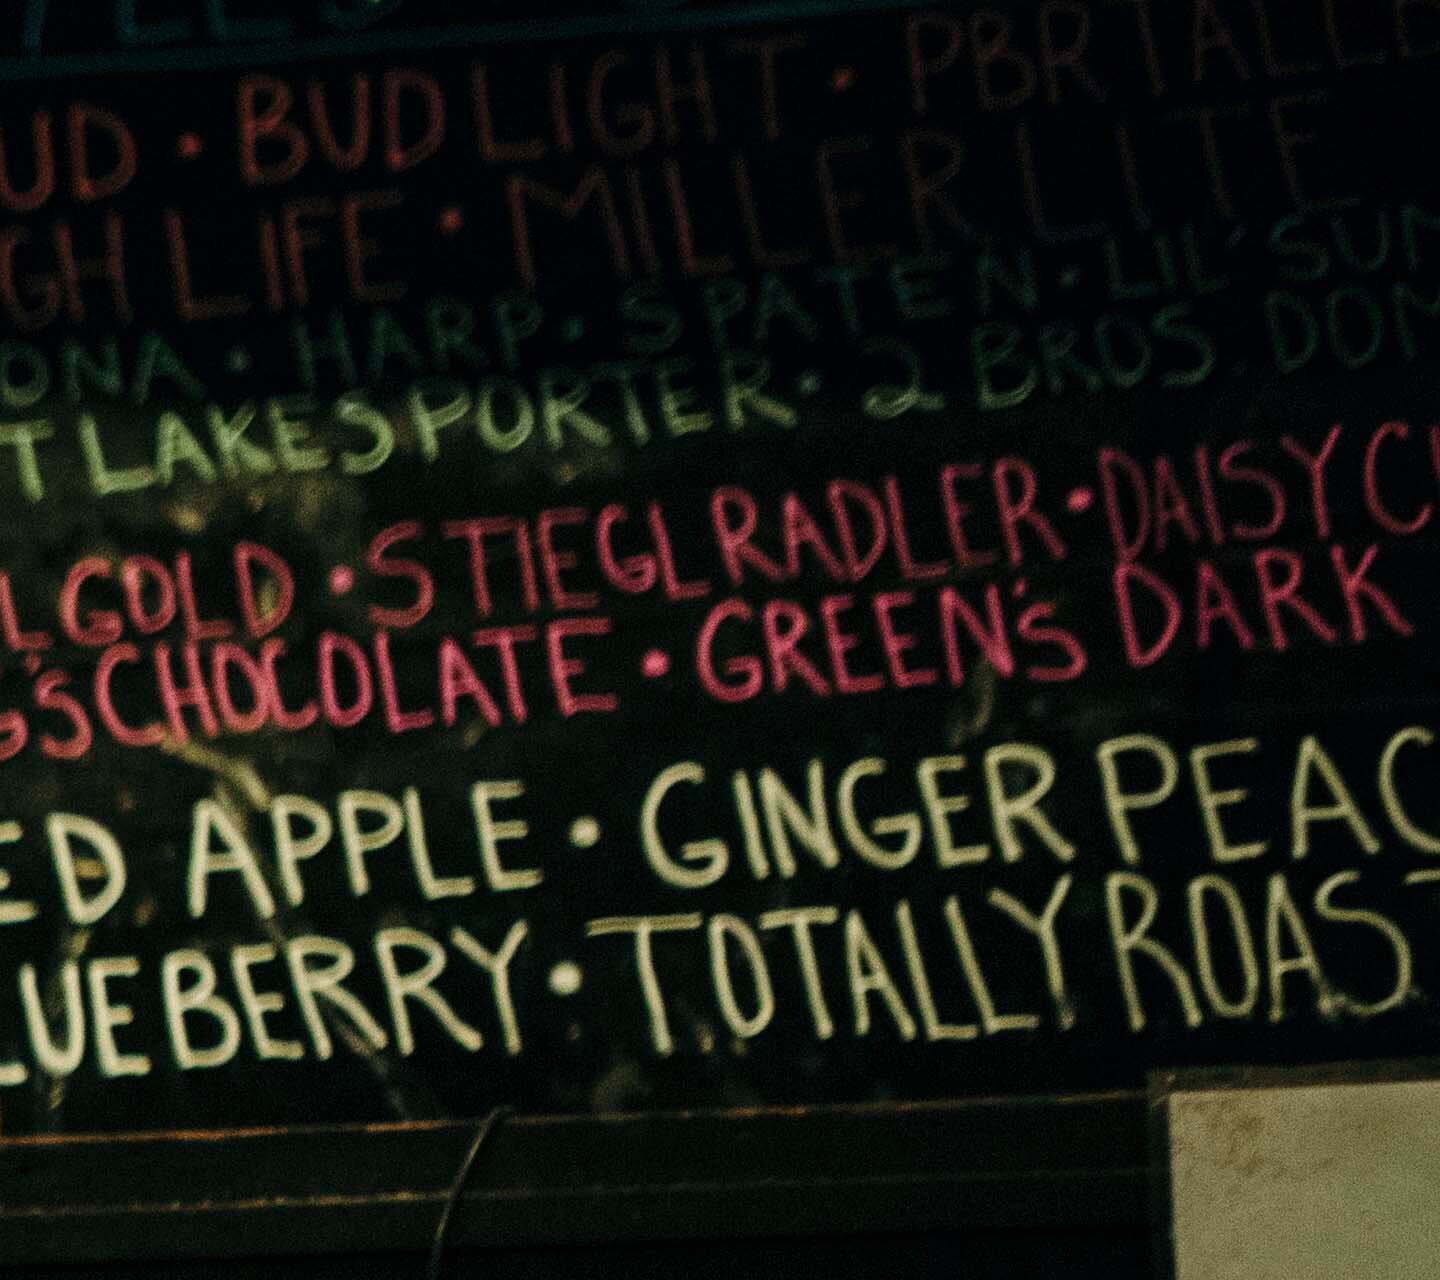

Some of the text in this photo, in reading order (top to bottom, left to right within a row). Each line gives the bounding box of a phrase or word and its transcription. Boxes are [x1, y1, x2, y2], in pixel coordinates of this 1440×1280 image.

[235, 67, 449, 189] BUD
[478, 29, 808, 162] LIGHT
[160, 190, 410, 320] LIFE
[505, 122, 980, 292] MILLER
[83, 395, 396, 496] LAKES
[416, 345, 798, 465] PORTER
[964, 297, 1218, 414] BROS
[285, 288, 544, 396] HARP
[617, 246, 1042, 356] SPATEN
[60, 542, 296, 649] GOLD
[368, 503, 713, 627] STIEGL
[710, 456, 1068, 582] RADLER
[1097, 421, 1343, 561] DAISY
[94, 616, 620, 746] CHOCOLATE
[696, 585, 1087, 704] GREEN'S
[1113, 544, 1415, 668] DARK
[188, 780, 545, 919] APPLE
[640, 743, 1076, 889] GINGER
[586, 873, 1078, 1055] TOTALLY
[1104, 868, 1440, 1033] ROAS
